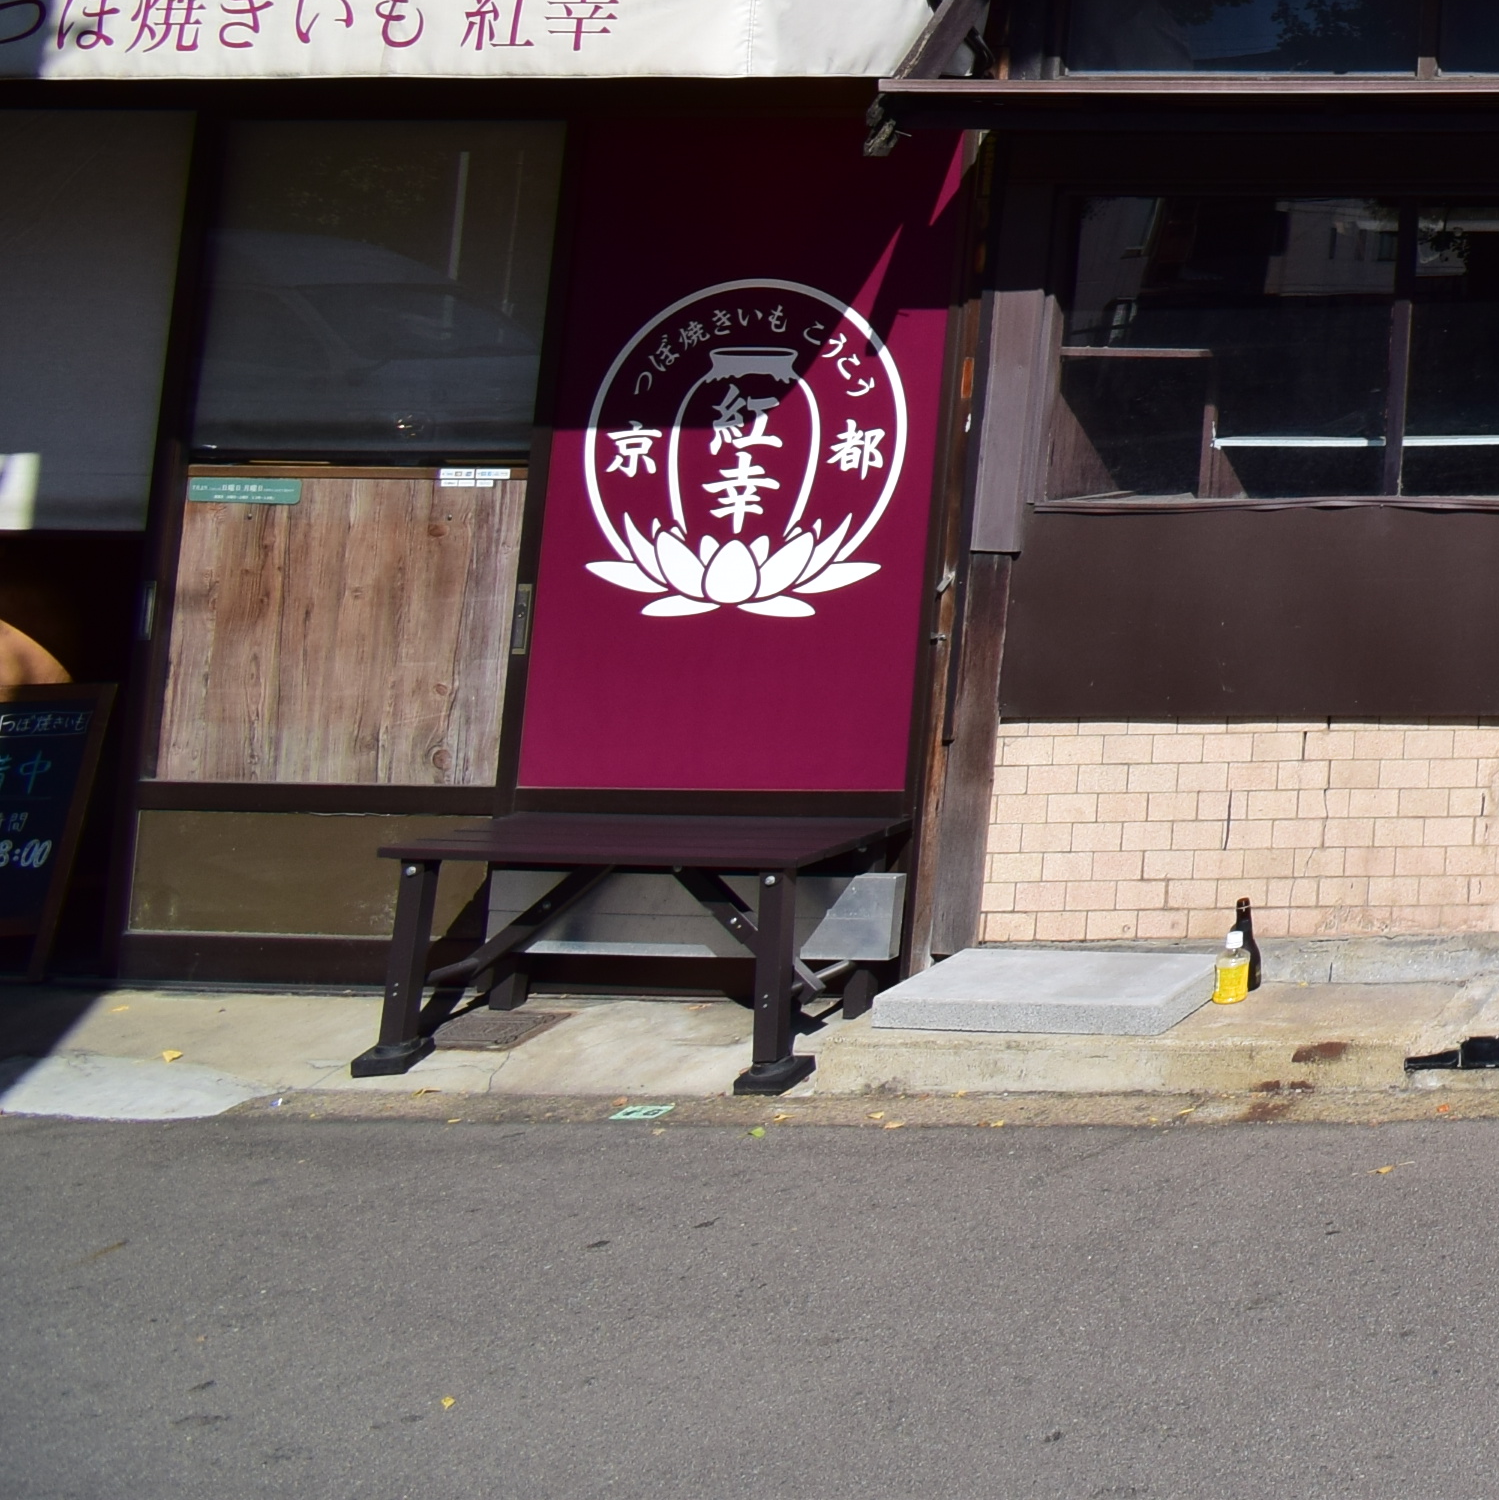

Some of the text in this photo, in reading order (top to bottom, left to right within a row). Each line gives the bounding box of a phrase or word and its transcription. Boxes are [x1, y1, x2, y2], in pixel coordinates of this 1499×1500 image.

[633, 304, 876, 398] つぼ焼きいも こうこう
[702, 383, 783, 534] 紅幸
[0, 811, 29, 833] 間
